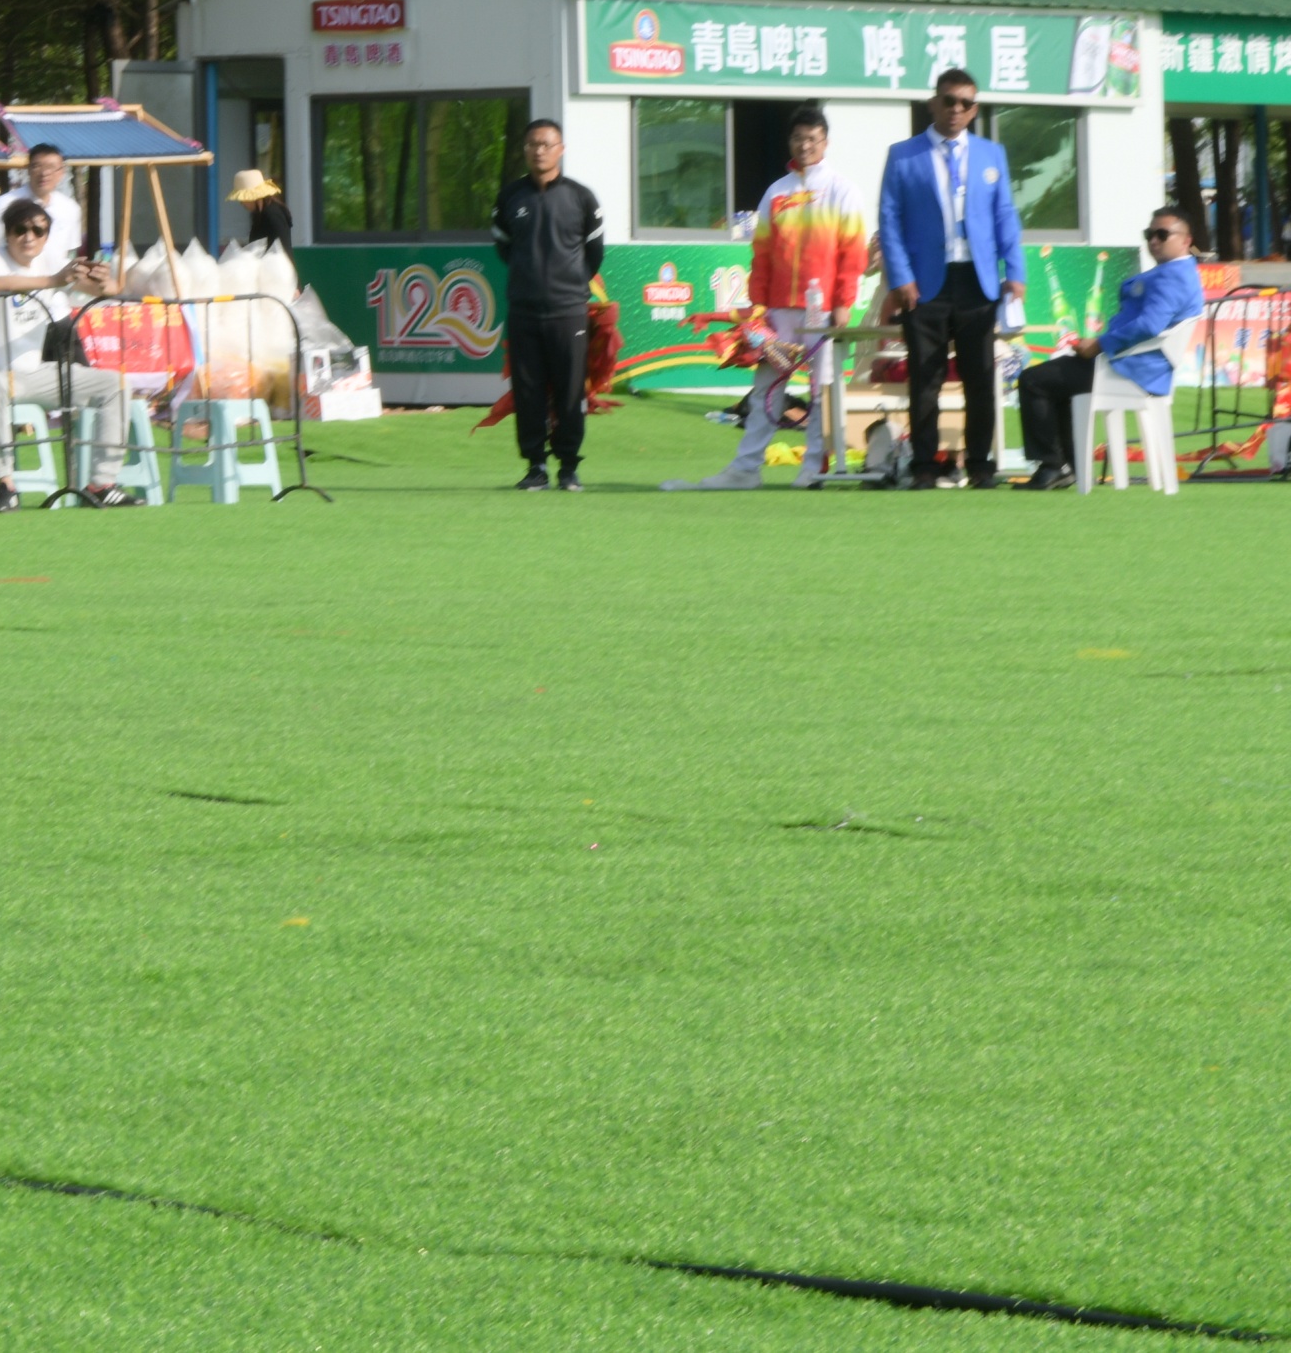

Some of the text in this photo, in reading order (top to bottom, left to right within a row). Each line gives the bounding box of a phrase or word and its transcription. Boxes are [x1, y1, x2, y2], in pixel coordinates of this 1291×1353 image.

[317, 3, 400, 26] TSINGTAO
[612, 47, 681, 71] TSINGTAO
[710, 265, 753, 313] 12
